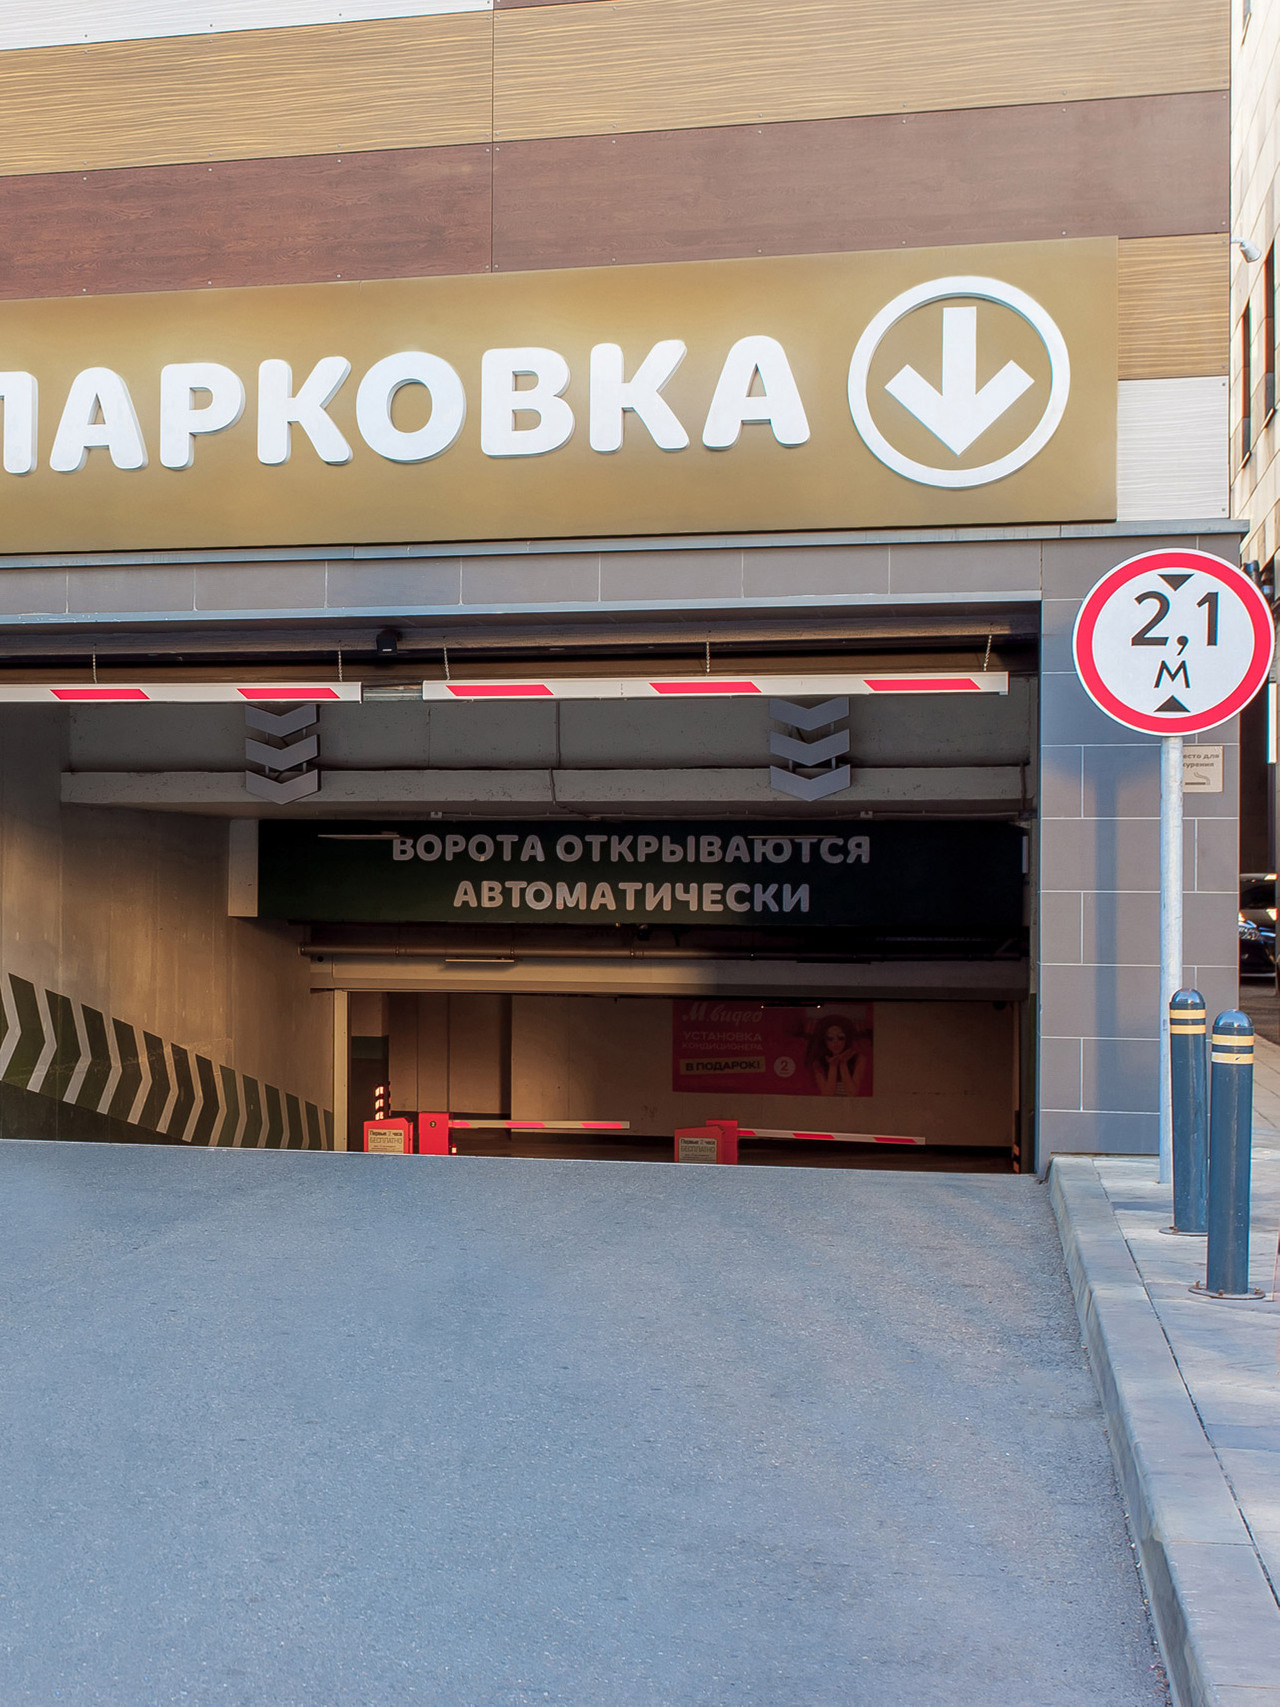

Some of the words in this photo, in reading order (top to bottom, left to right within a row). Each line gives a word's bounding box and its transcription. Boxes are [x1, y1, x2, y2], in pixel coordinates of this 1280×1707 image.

[1131, 591, 1219, 656] 2,1
[392, 834, 546, 863] ВОРОТА
[556, 834, 871, 865] ОТКРЫВАЮТСЯ
[453, 880, 811, 914] АВТОМАТИЧЕСКИ
[684, 1030, 762, 1042] УСТАНОВКА
[685, 1062, 694, 1072] В
[696, 1060, 761, 1072] ПОДАРОК!
